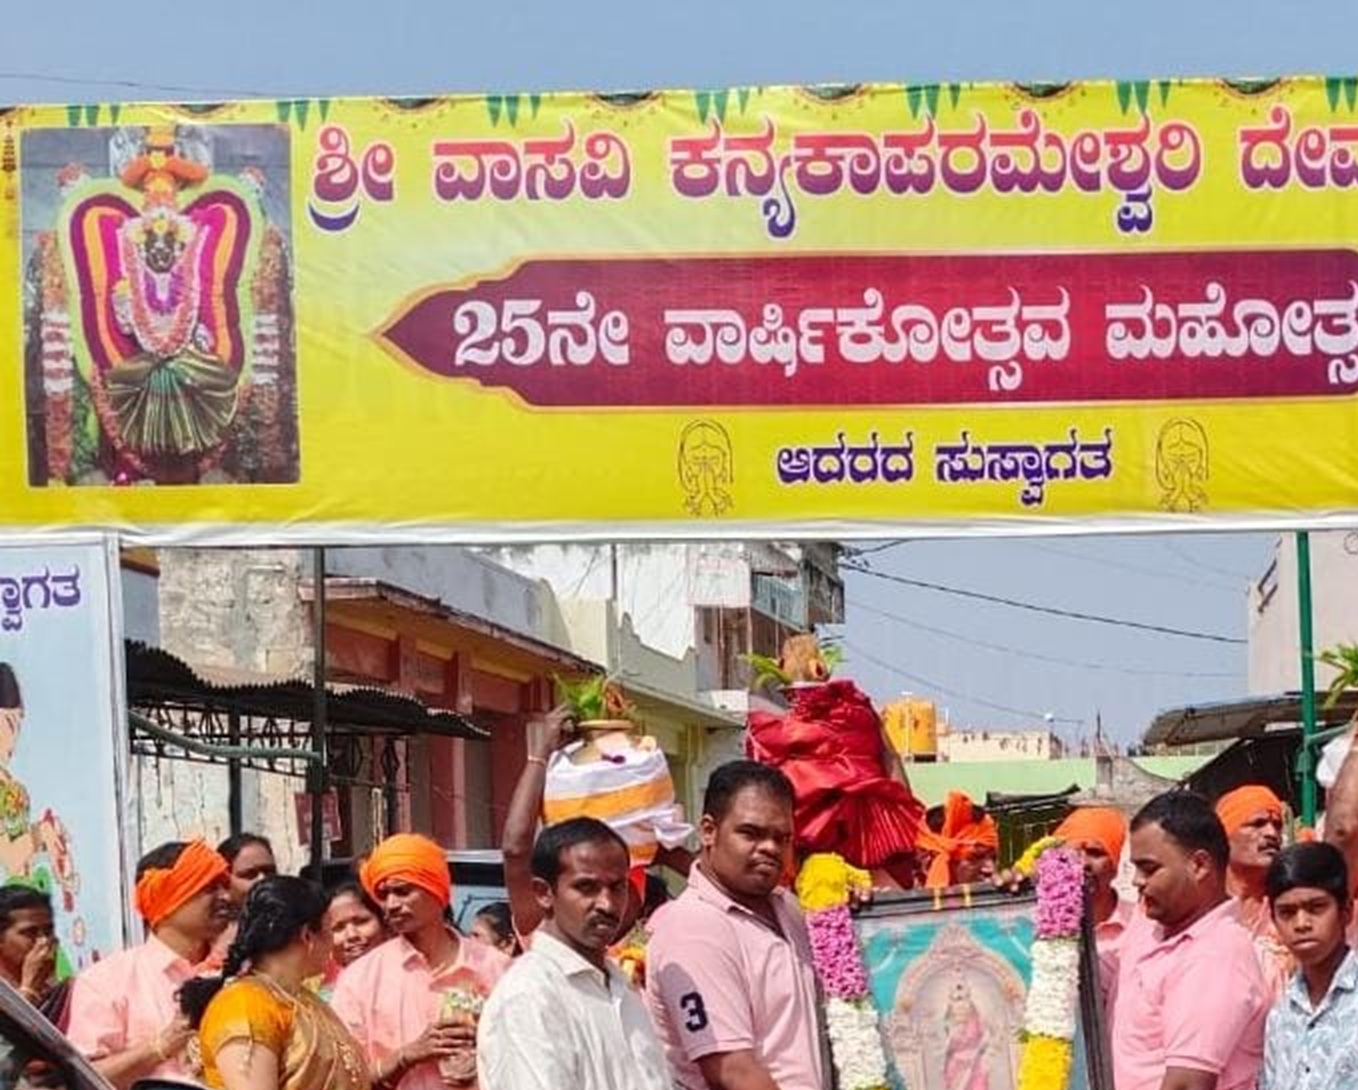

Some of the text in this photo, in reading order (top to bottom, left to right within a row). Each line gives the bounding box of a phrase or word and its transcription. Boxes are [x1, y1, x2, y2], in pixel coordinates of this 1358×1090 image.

[308, 126, 394, 232] ಶ್ರೀ
[432, 117, 632, 203] ವಾಸವಿ
[670, 109, 1200, 238] ಕನ್ಯಕಾಪರಮೇಶ್ವರಿ
[452, 290, 630, 366] 25ನೇ
[663, 285, 1071, 392] ವಾರ್ಷಿಕೋತ್ಸವ
[777, 428, 1113, 506] ಆದರದ ಸುಸ್ವಾಗತ
[680, 991, 708, 1033] 3
